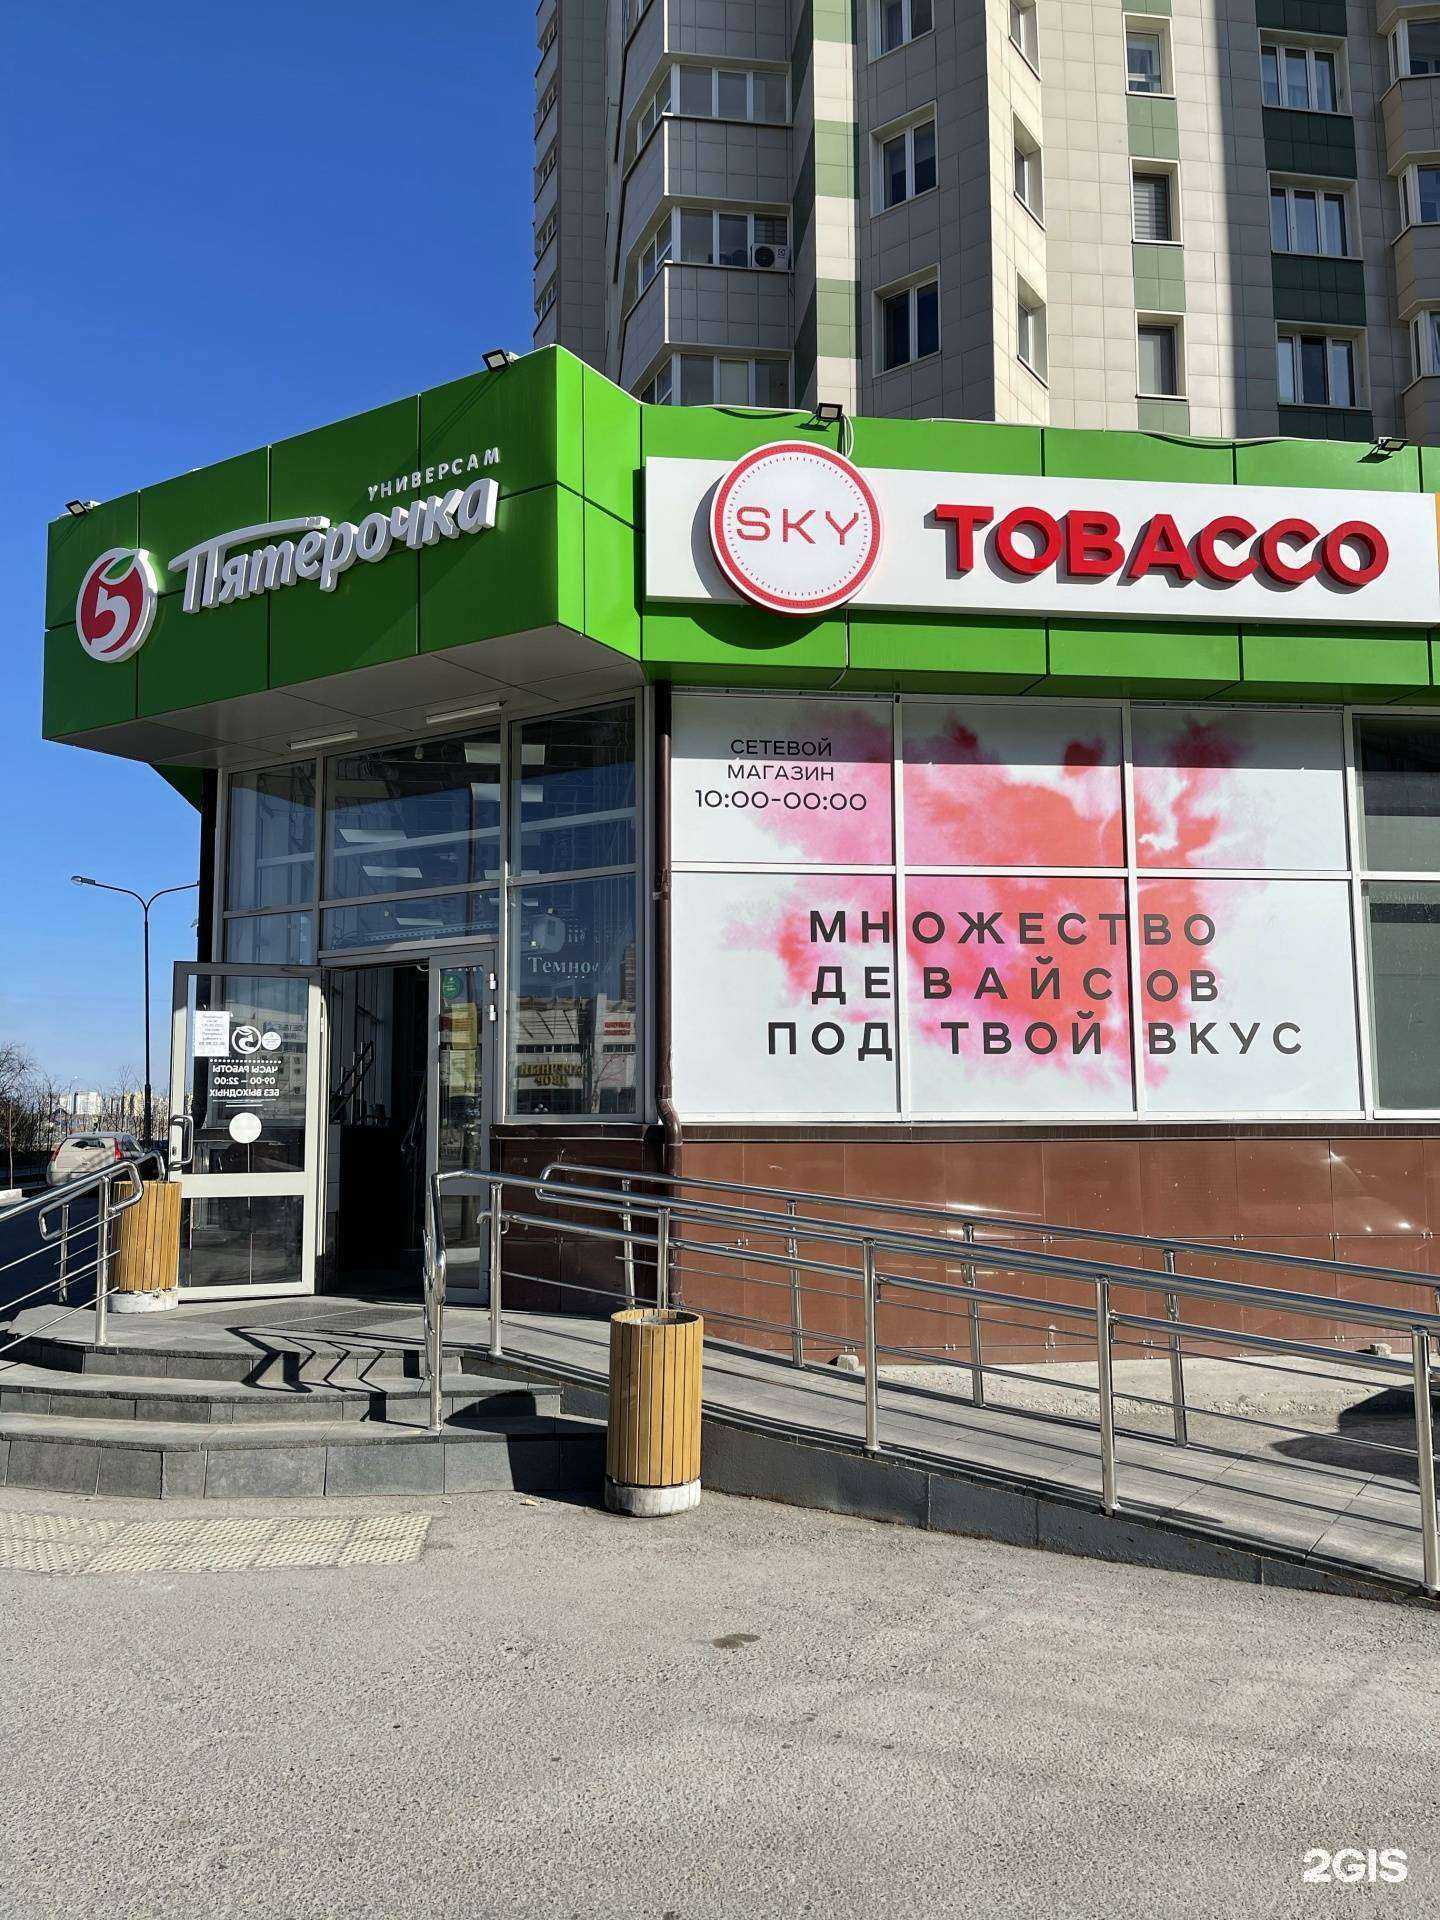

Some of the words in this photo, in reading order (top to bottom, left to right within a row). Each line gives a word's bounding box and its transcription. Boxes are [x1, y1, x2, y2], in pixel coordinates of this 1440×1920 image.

[368, 446, 500, 501] УНИВЕРСАМ
[736, 504, 861, 546] SKY
[934, 503, 1389, 587] TOBACCO
[730, 737, 832, 757] СЕТЕВОЙ
[727, 764, 834, 781] МАГАЗИН
[695, 789, 867, 811] 10:00-00:00
[809, 910, 1217, 946] МНОЖЕСТВО
[811, 956, 1219, 1005] ДЕВАЙСОВ
[768, 1021, 893, 1061] ПОД
[940, 1010, 1102, 1055] ТВОЙ
[1149, 1022, 1302, 1056] ВКУС
